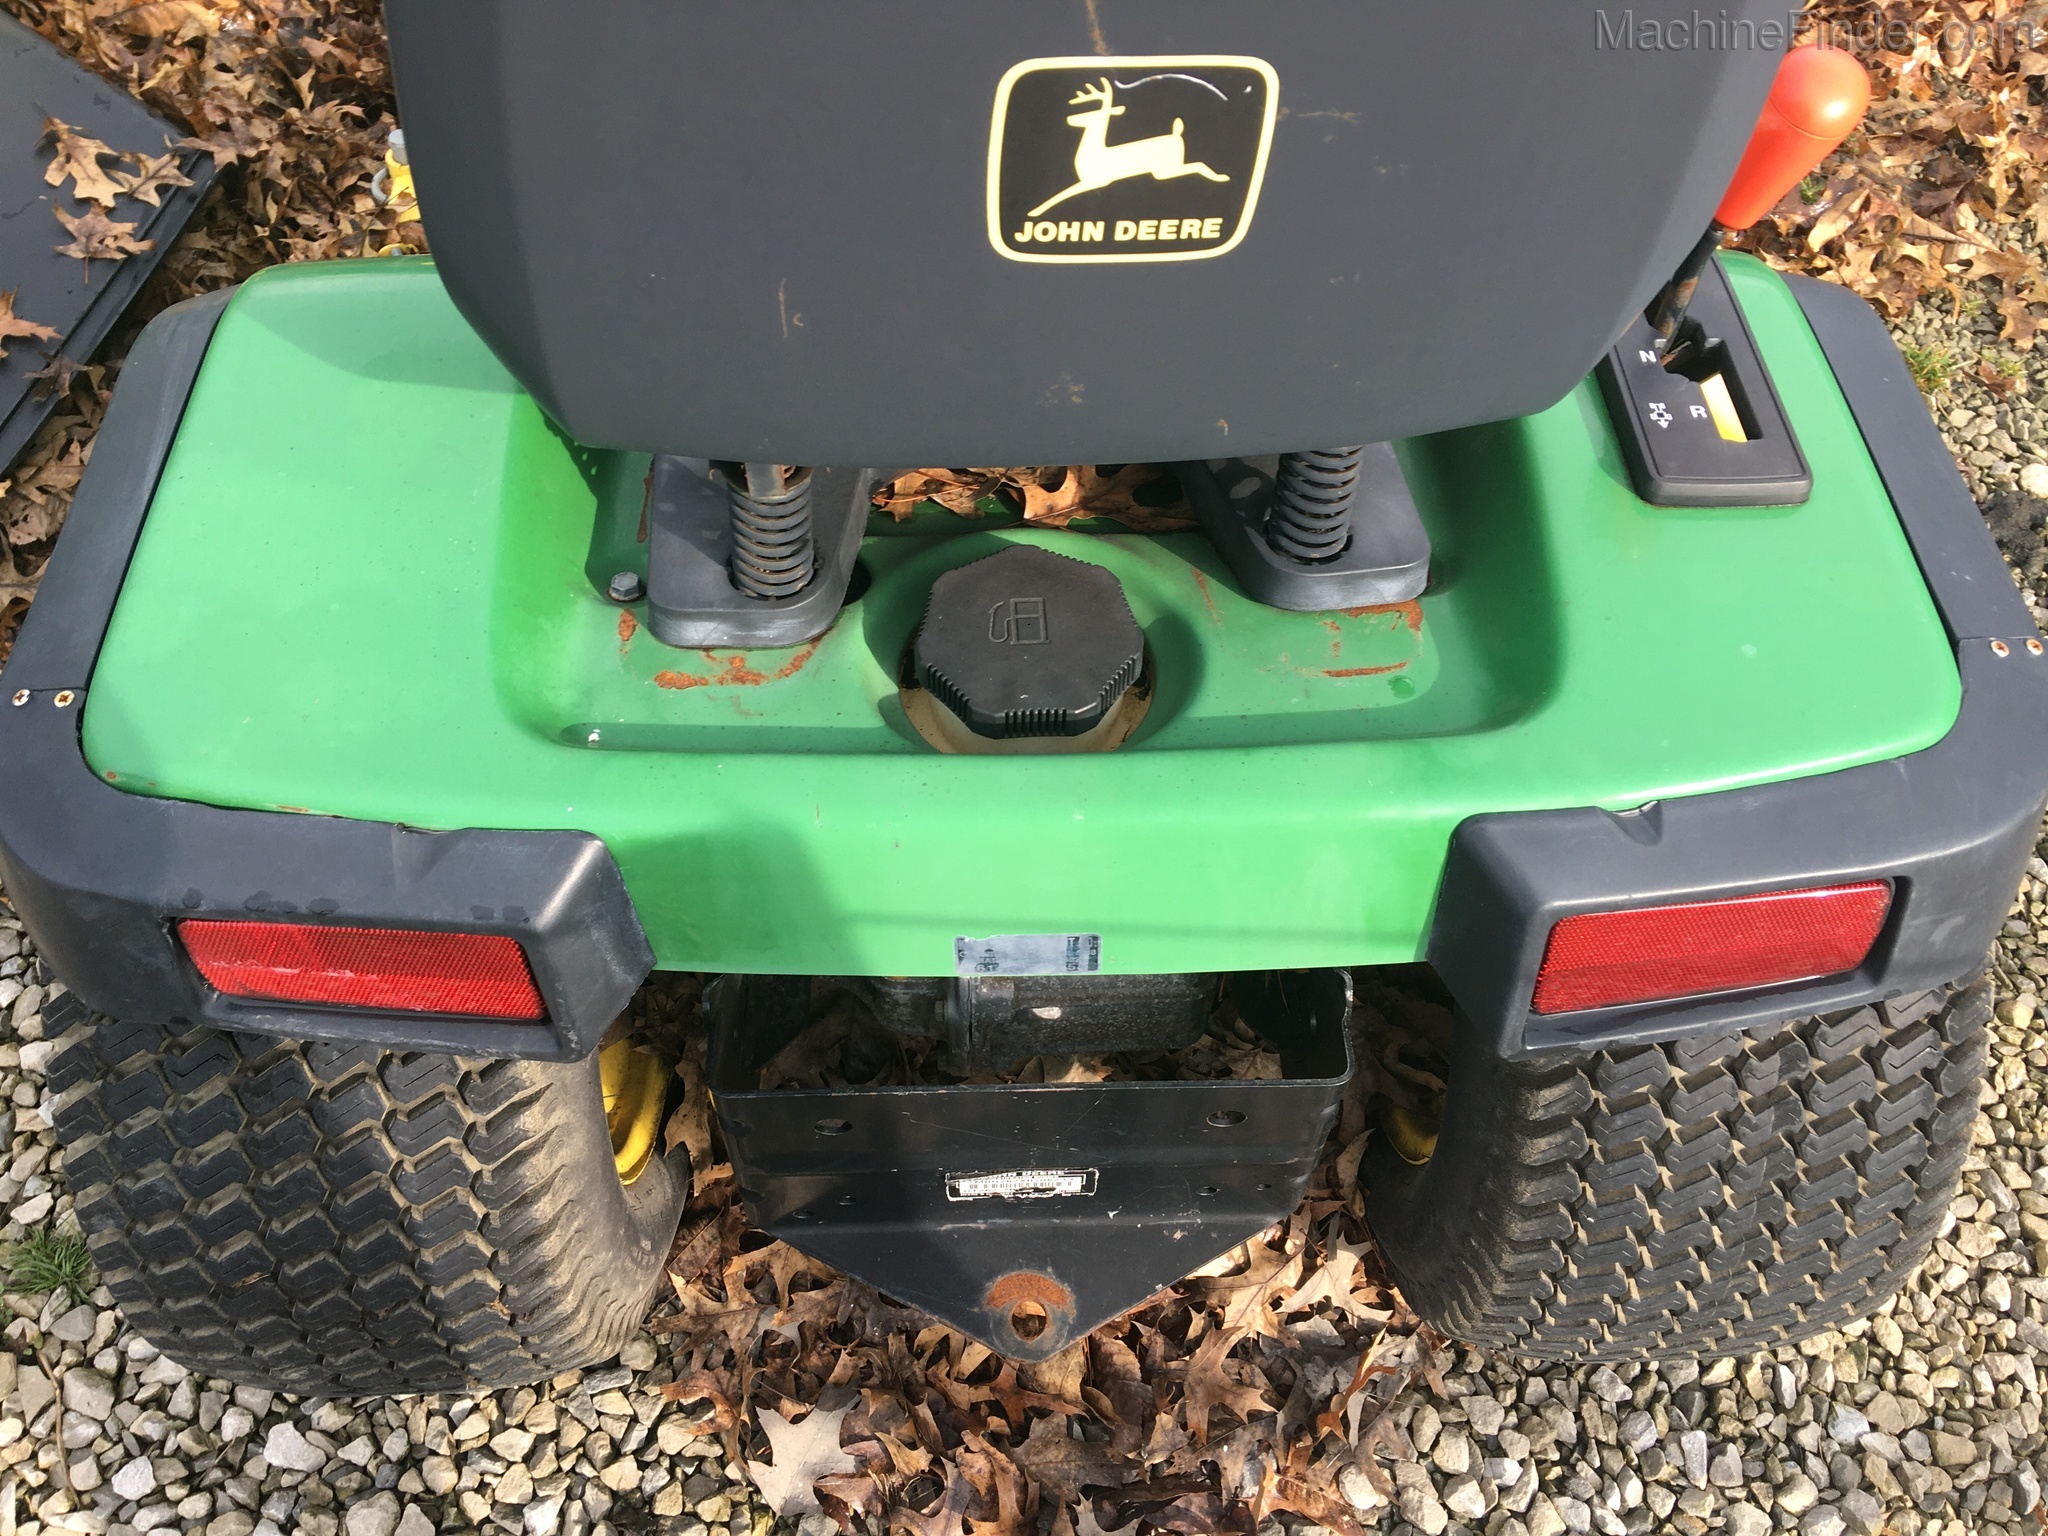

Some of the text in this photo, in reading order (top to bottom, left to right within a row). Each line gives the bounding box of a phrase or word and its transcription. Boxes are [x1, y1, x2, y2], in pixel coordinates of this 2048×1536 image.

[1014, 217, 1223, 243] JOHN DEERE
[1638, 350, 1657, 363] N
[1689, 405, 1708, 418] R
